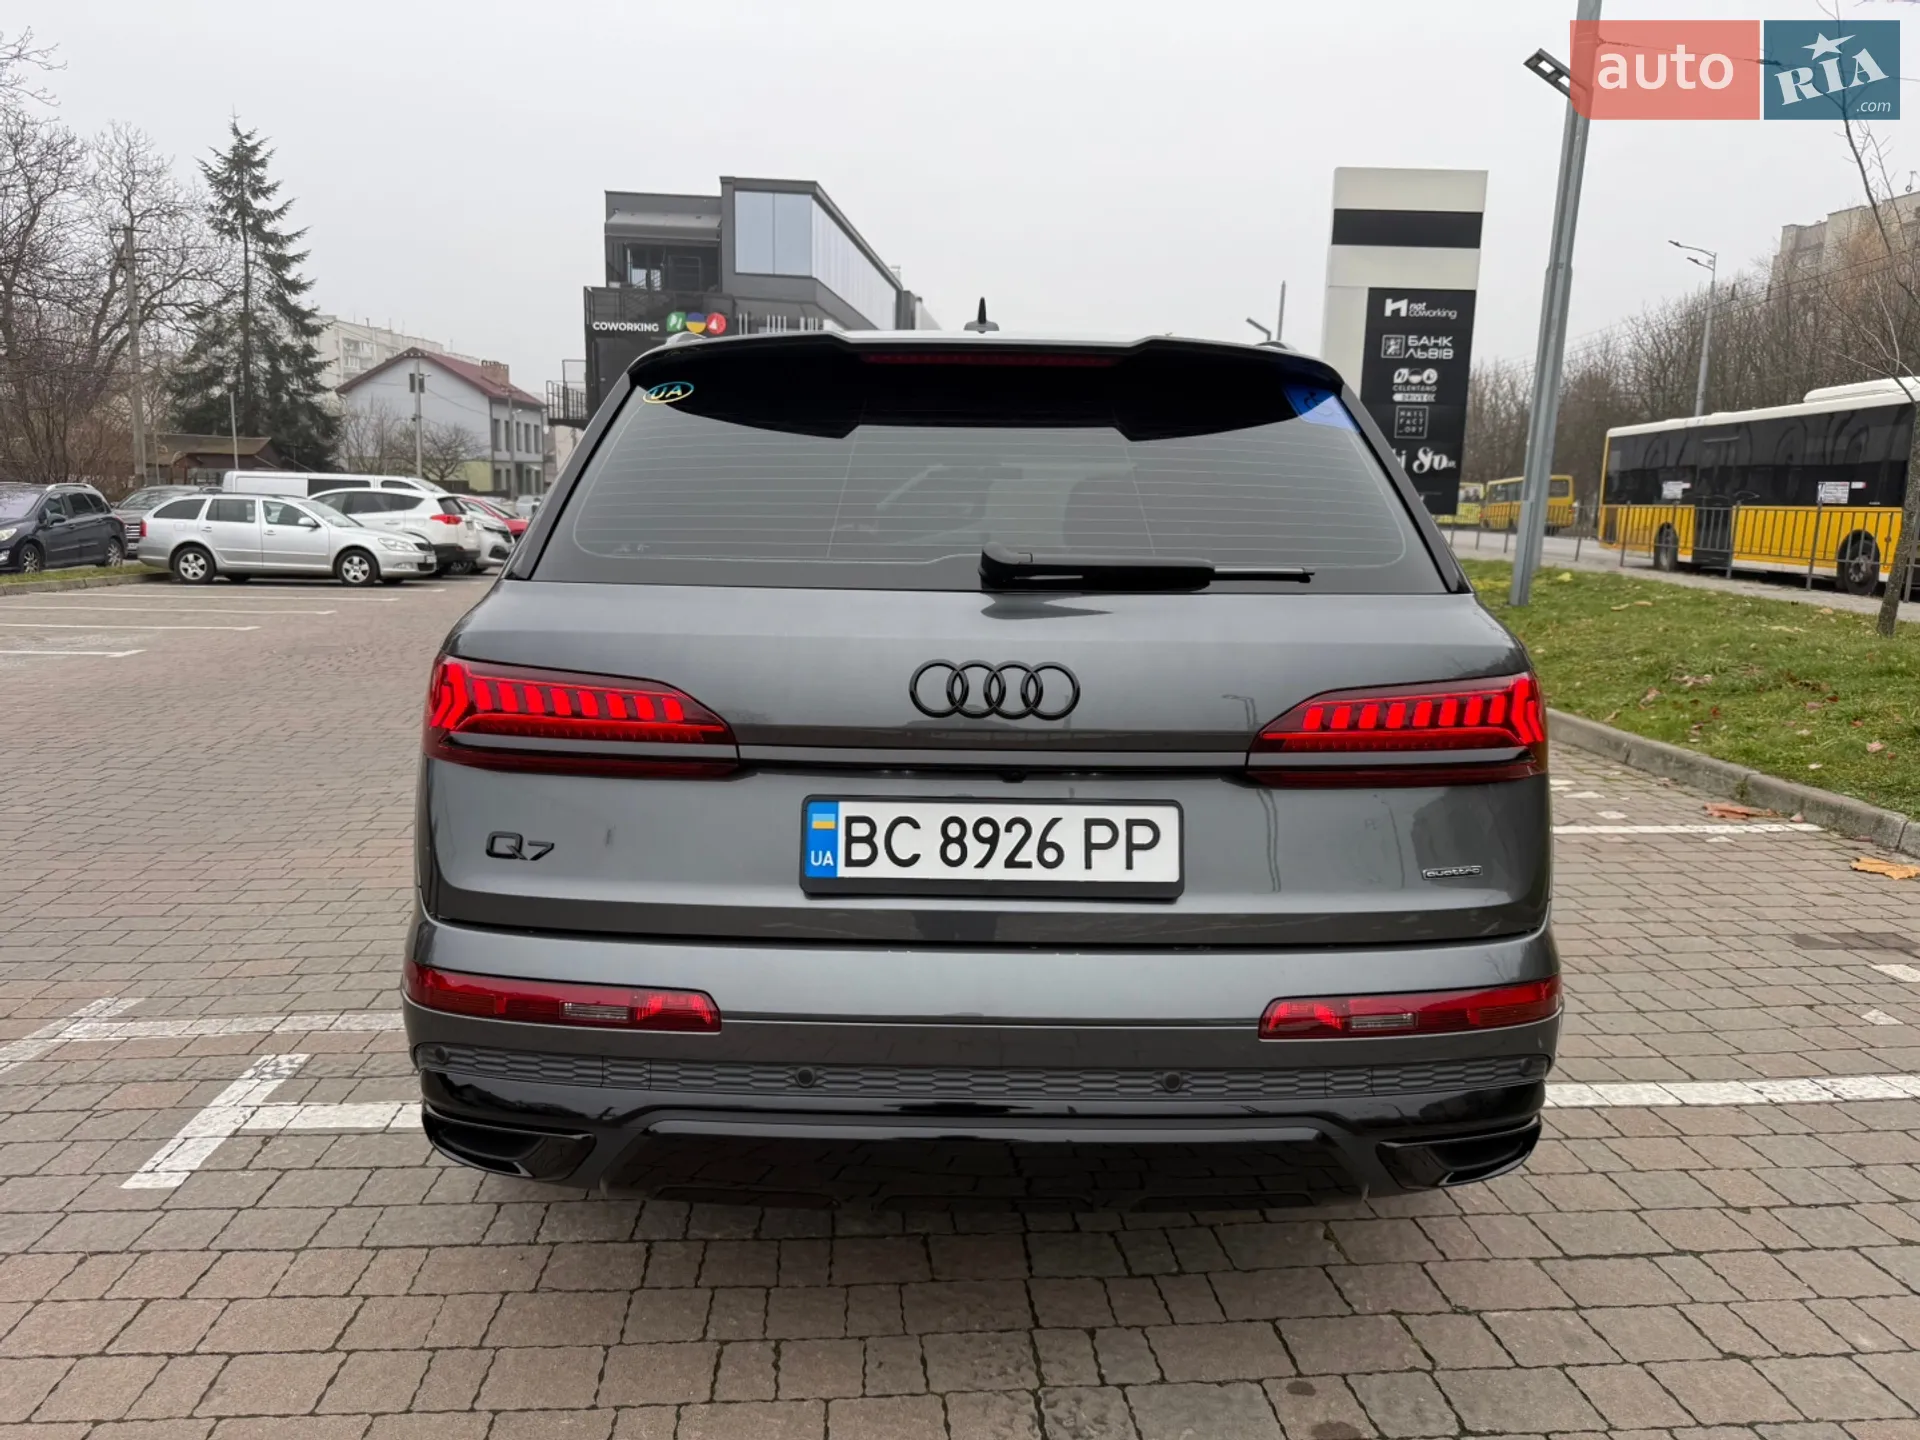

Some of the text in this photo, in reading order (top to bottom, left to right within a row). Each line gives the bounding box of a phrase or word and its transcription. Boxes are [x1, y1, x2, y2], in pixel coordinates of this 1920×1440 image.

[1408, 308, 1458, 320] coworking
[592, 321, 660, 332] COWORKING
[1407, 335, 1453, 347] БАНК
[1405, 348, 1454, 359] ЛЬВІВ
[650, 385, 683, 401] UA
[486, 831, 555, 861] Q7
[844, 815, 1161, 871] BC 8926 PP
[810, 850, 834, 867] UA
